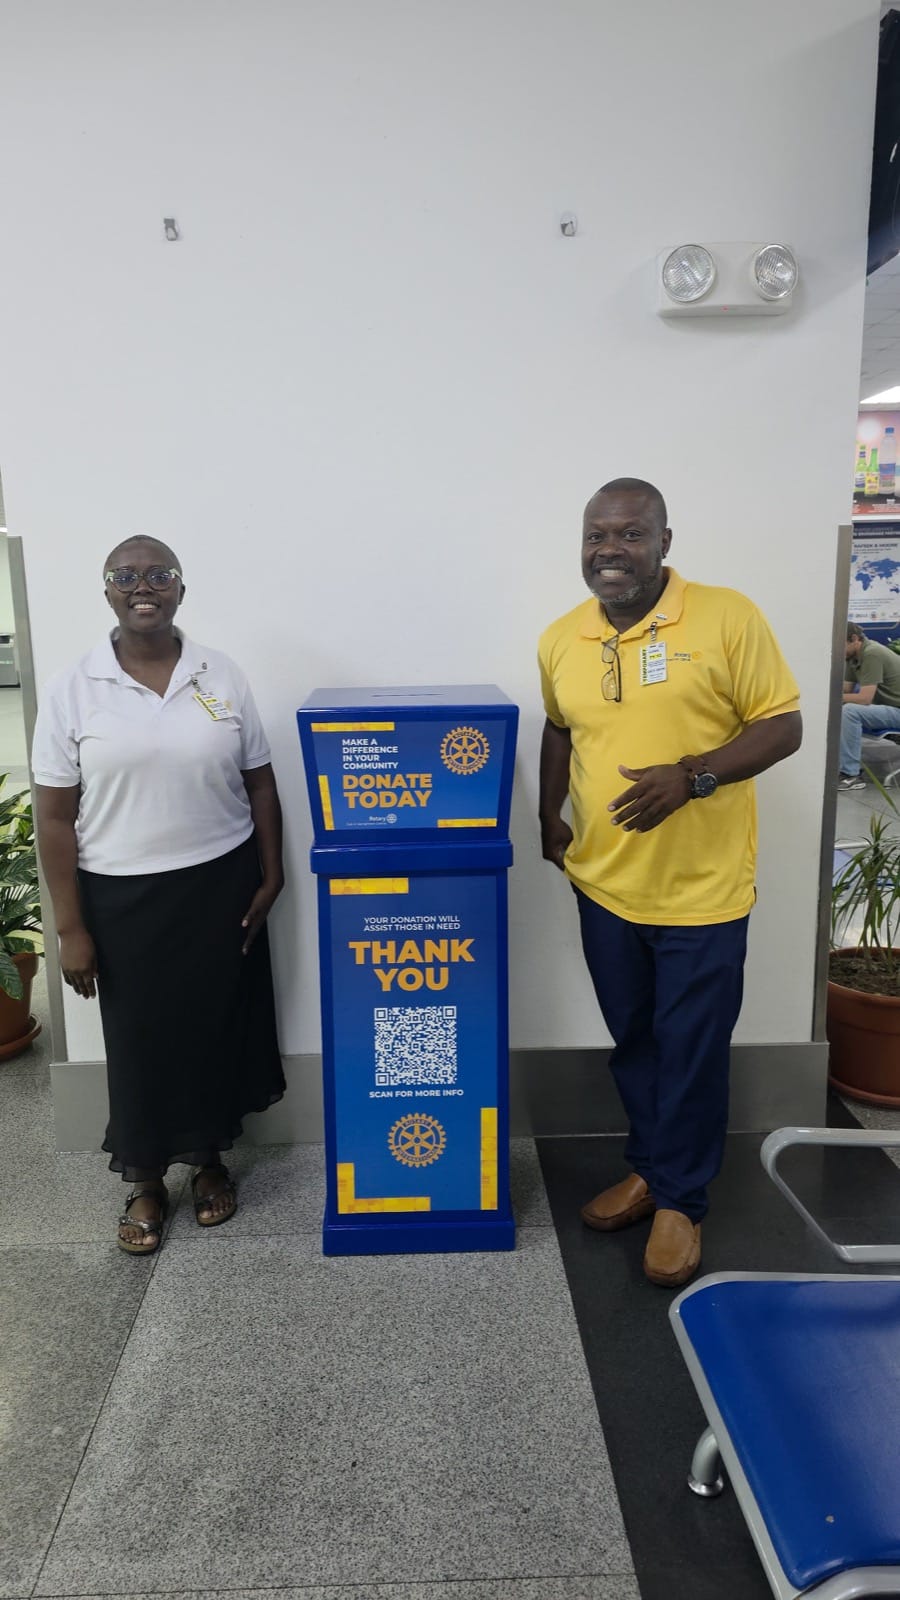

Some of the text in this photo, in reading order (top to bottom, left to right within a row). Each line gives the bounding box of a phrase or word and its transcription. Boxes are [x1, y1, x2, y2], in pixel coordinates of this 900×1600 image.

[342, 738, 378, 746] MAKE A
[342, 746, 398, 754] DIFFERENCE
[343, 754, 380, 762] IN YOUR
[343, 762, 399, 770] COMMUNITY
[343, 773, 433, 790] DONATE
[343, 790, 433, 809] TODAY
[364, 916, 389, 924] YOUR
[363, 924, 392, 932] ASSIST
[395, 923, 423, 931] THOSE
[436, 922, 461, 930] NEED
[348, 938, 476, 965] THANK
[373, 967, 449, 992] YOU
